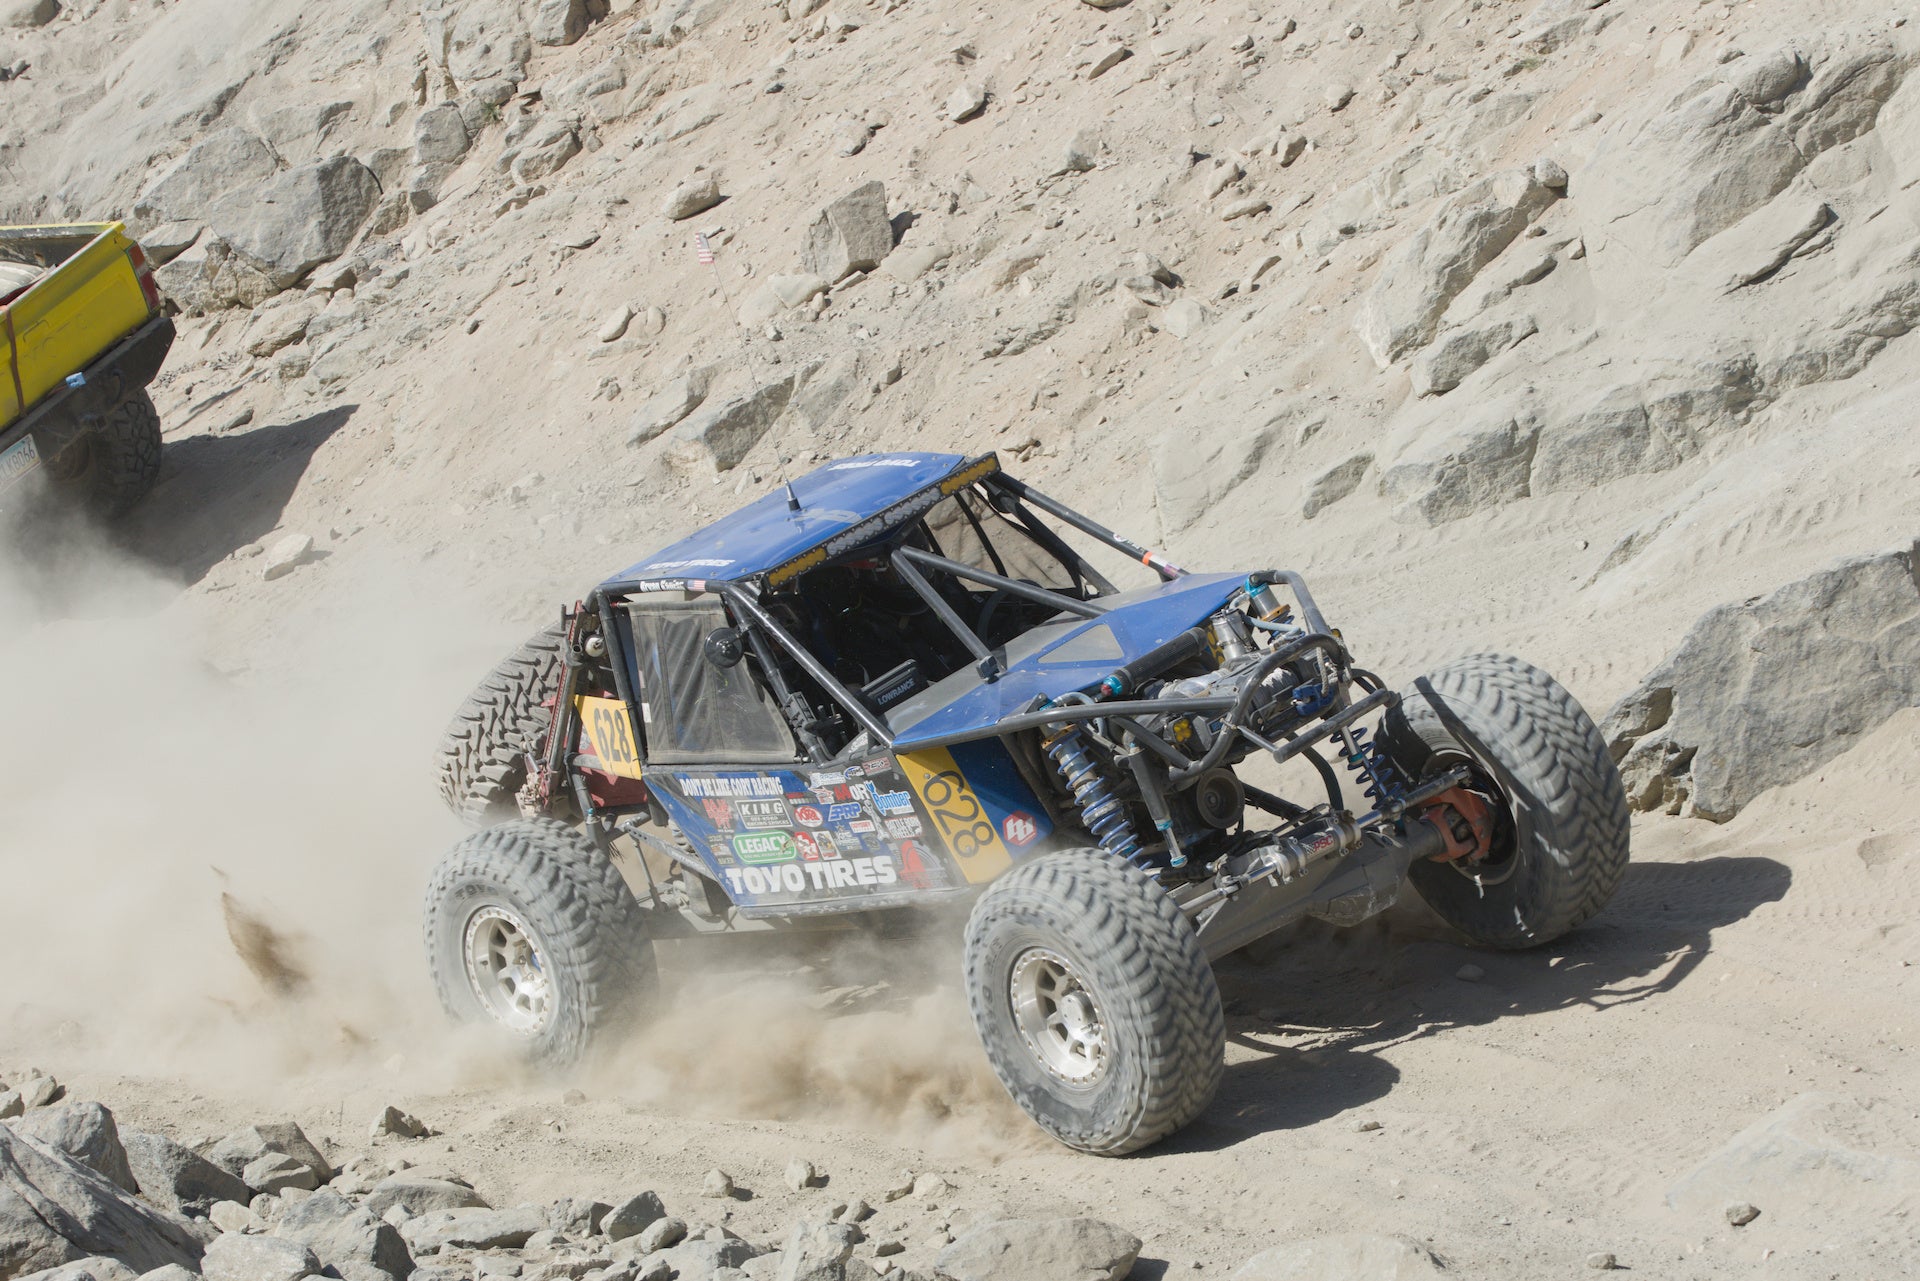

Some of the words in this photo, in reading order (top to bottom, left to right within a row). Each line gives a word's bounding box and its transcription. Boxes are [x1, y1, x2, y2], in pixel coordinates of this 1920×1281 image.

[877, 678, 914, 705] LOWRANCE
[593, 708, 632, 764] 628
[701, 779, 716, 796] BE
[711, 778, 733, 796] LIKE
[730, 778, 754, 796] CORY
[750, 777, 784, 795] RACING
[741, 802, 784, 815] KING
[873, 791, 911, 812] Bomber
[923, 770, 994, 858] 628
[738, 836, 787, 854] LEGACY
[1313, 834, 1335, 852] PSC
[725, 863, 806, 896] TOYO
[803, 855, 898, 891] TIRES
